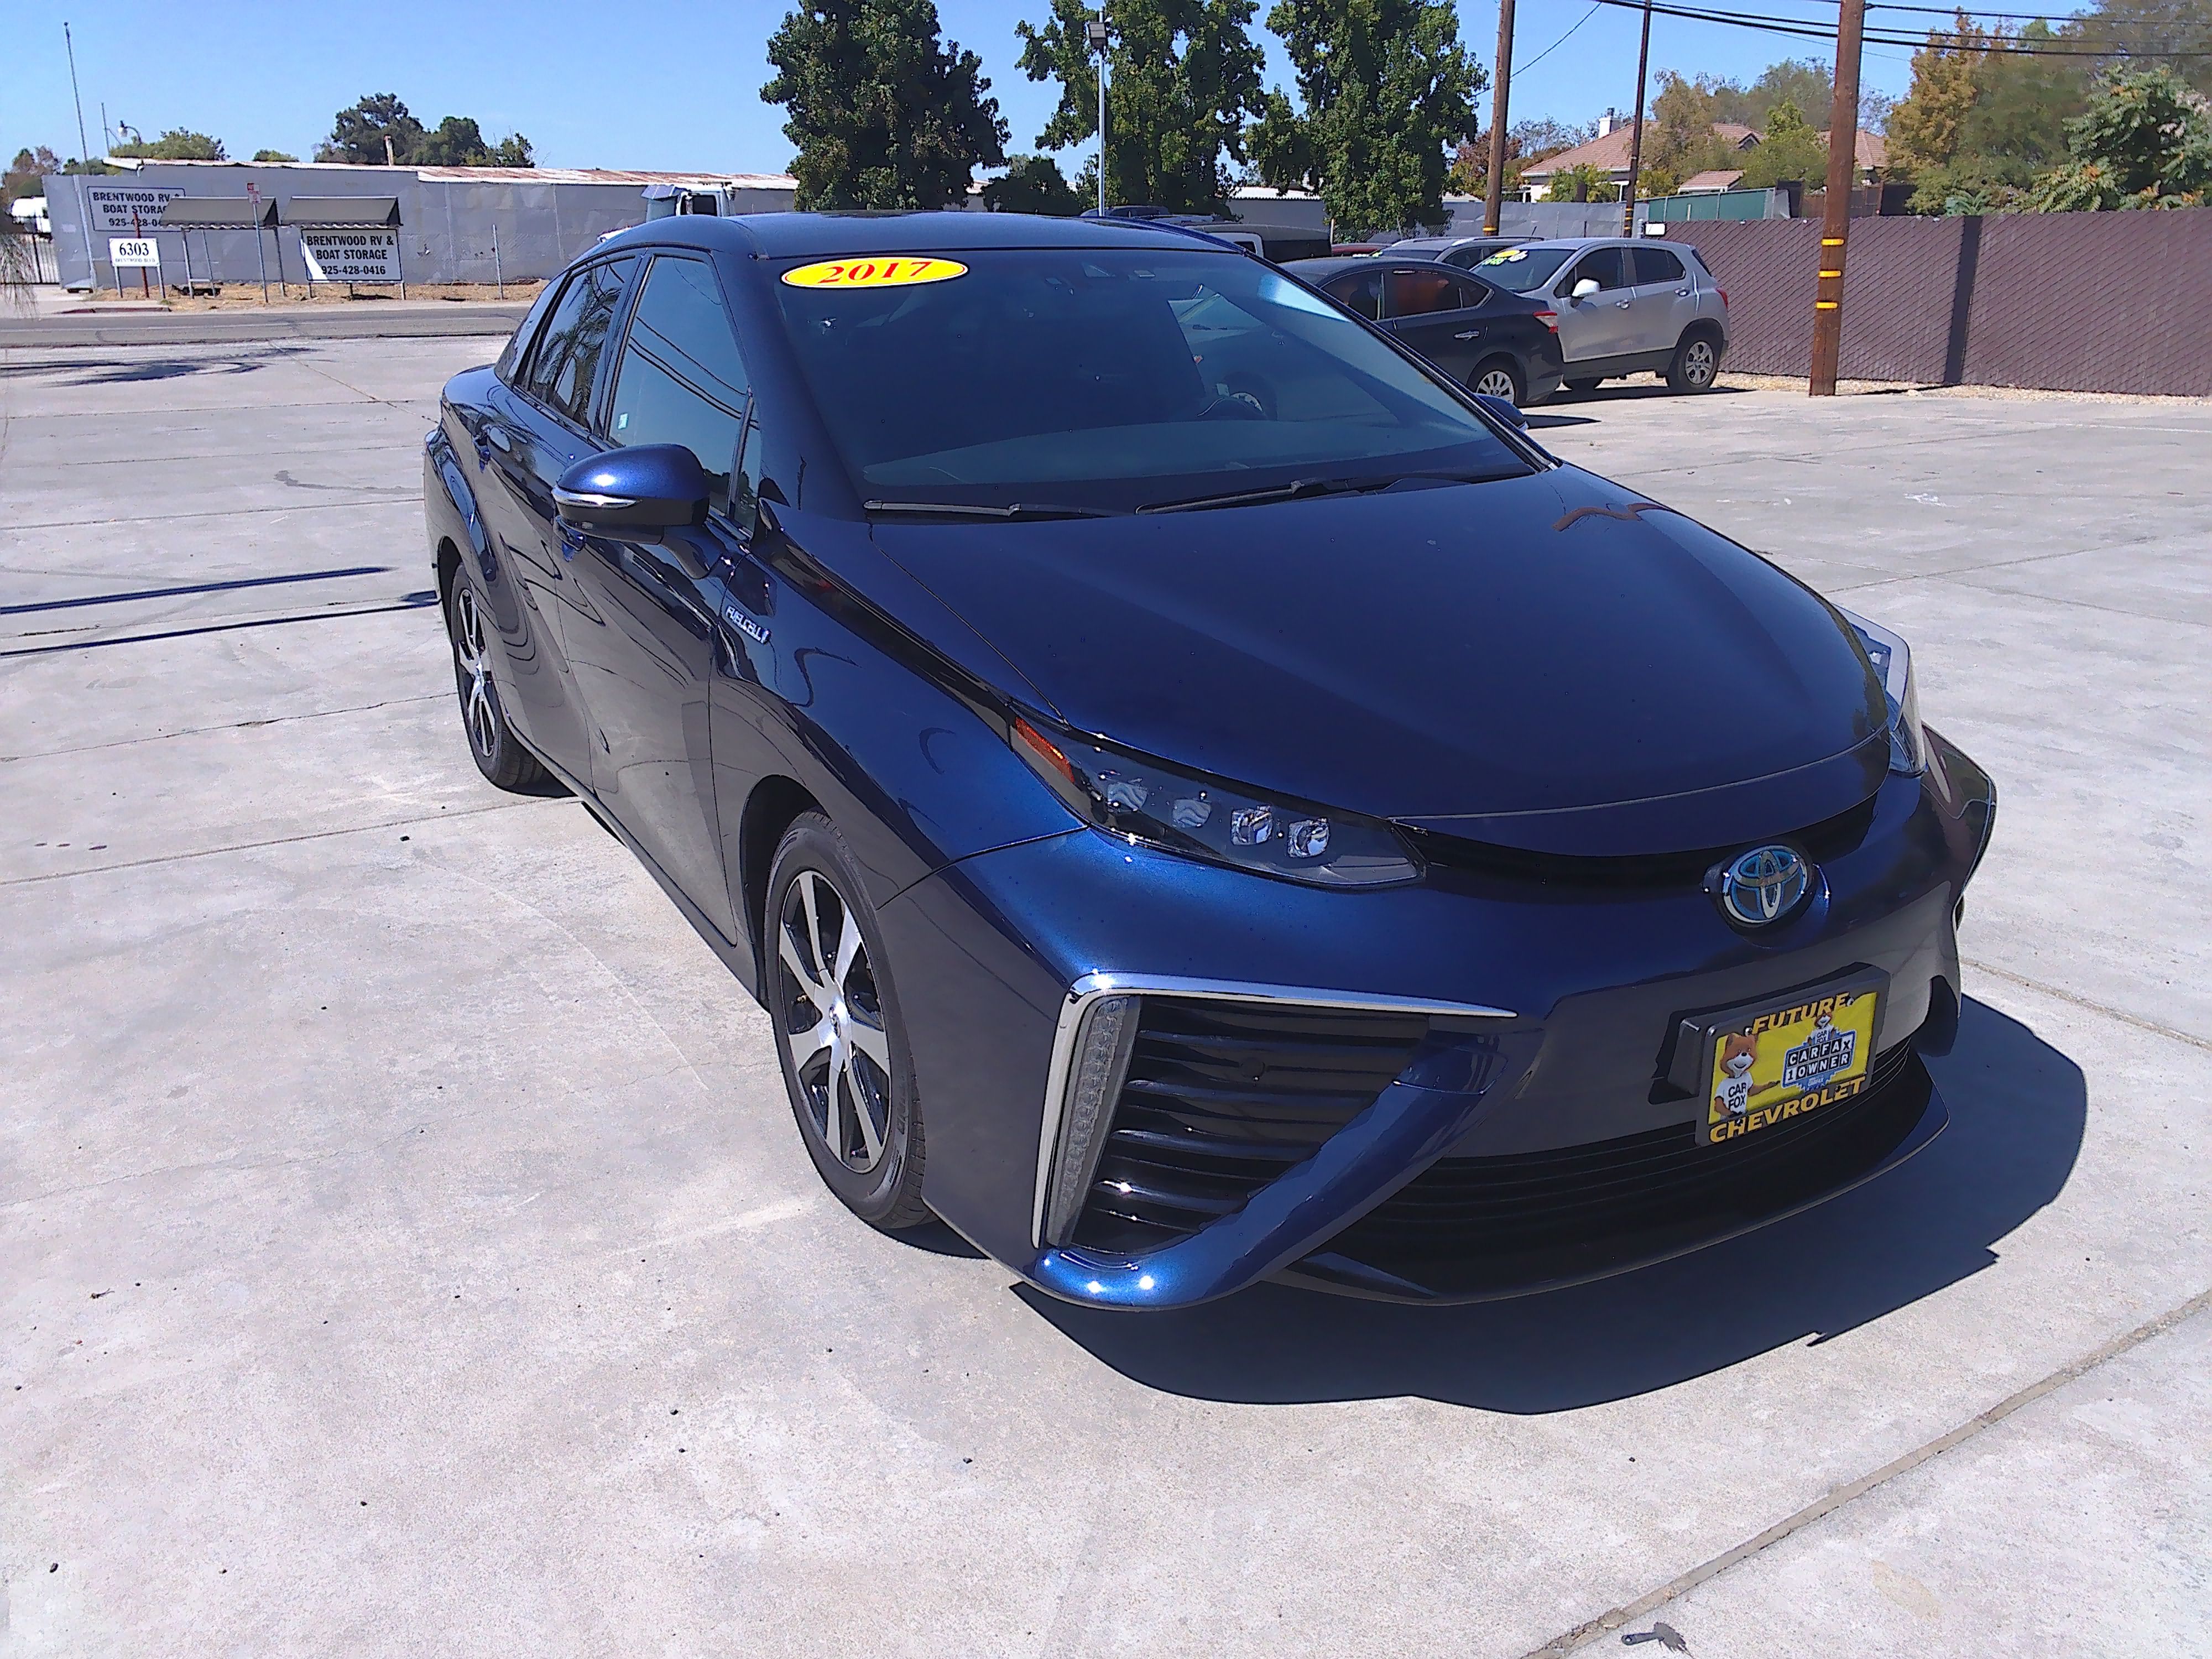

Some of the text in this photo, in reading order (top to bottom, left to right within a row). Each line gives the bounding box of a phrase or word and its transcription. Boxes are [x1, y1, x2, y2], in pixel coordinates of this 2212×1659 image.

[92, 192, 170, 202] BRENTWOOD RV
[103, 205, 167, 214] BOAT STORA
[307, 236, 394, 246] BRENTWOOD RV &
[119, 243, 149, 255] 6303
[316, 249, 388, 259] BOAT STORAGE
[322, 265, 386, 275] 925-428-0416
[817, 262, 933, 284] 2017
[1752, 992, 1850, 1035] FUTURE
[1790, 1040, 1850, 1065] CARFAX
[1728, 1082, 1747, 1098] CAR
[1728, 1094, 1745, 1110] FOX
[1709, 1076, 1866, 1143] CHEVROLET
